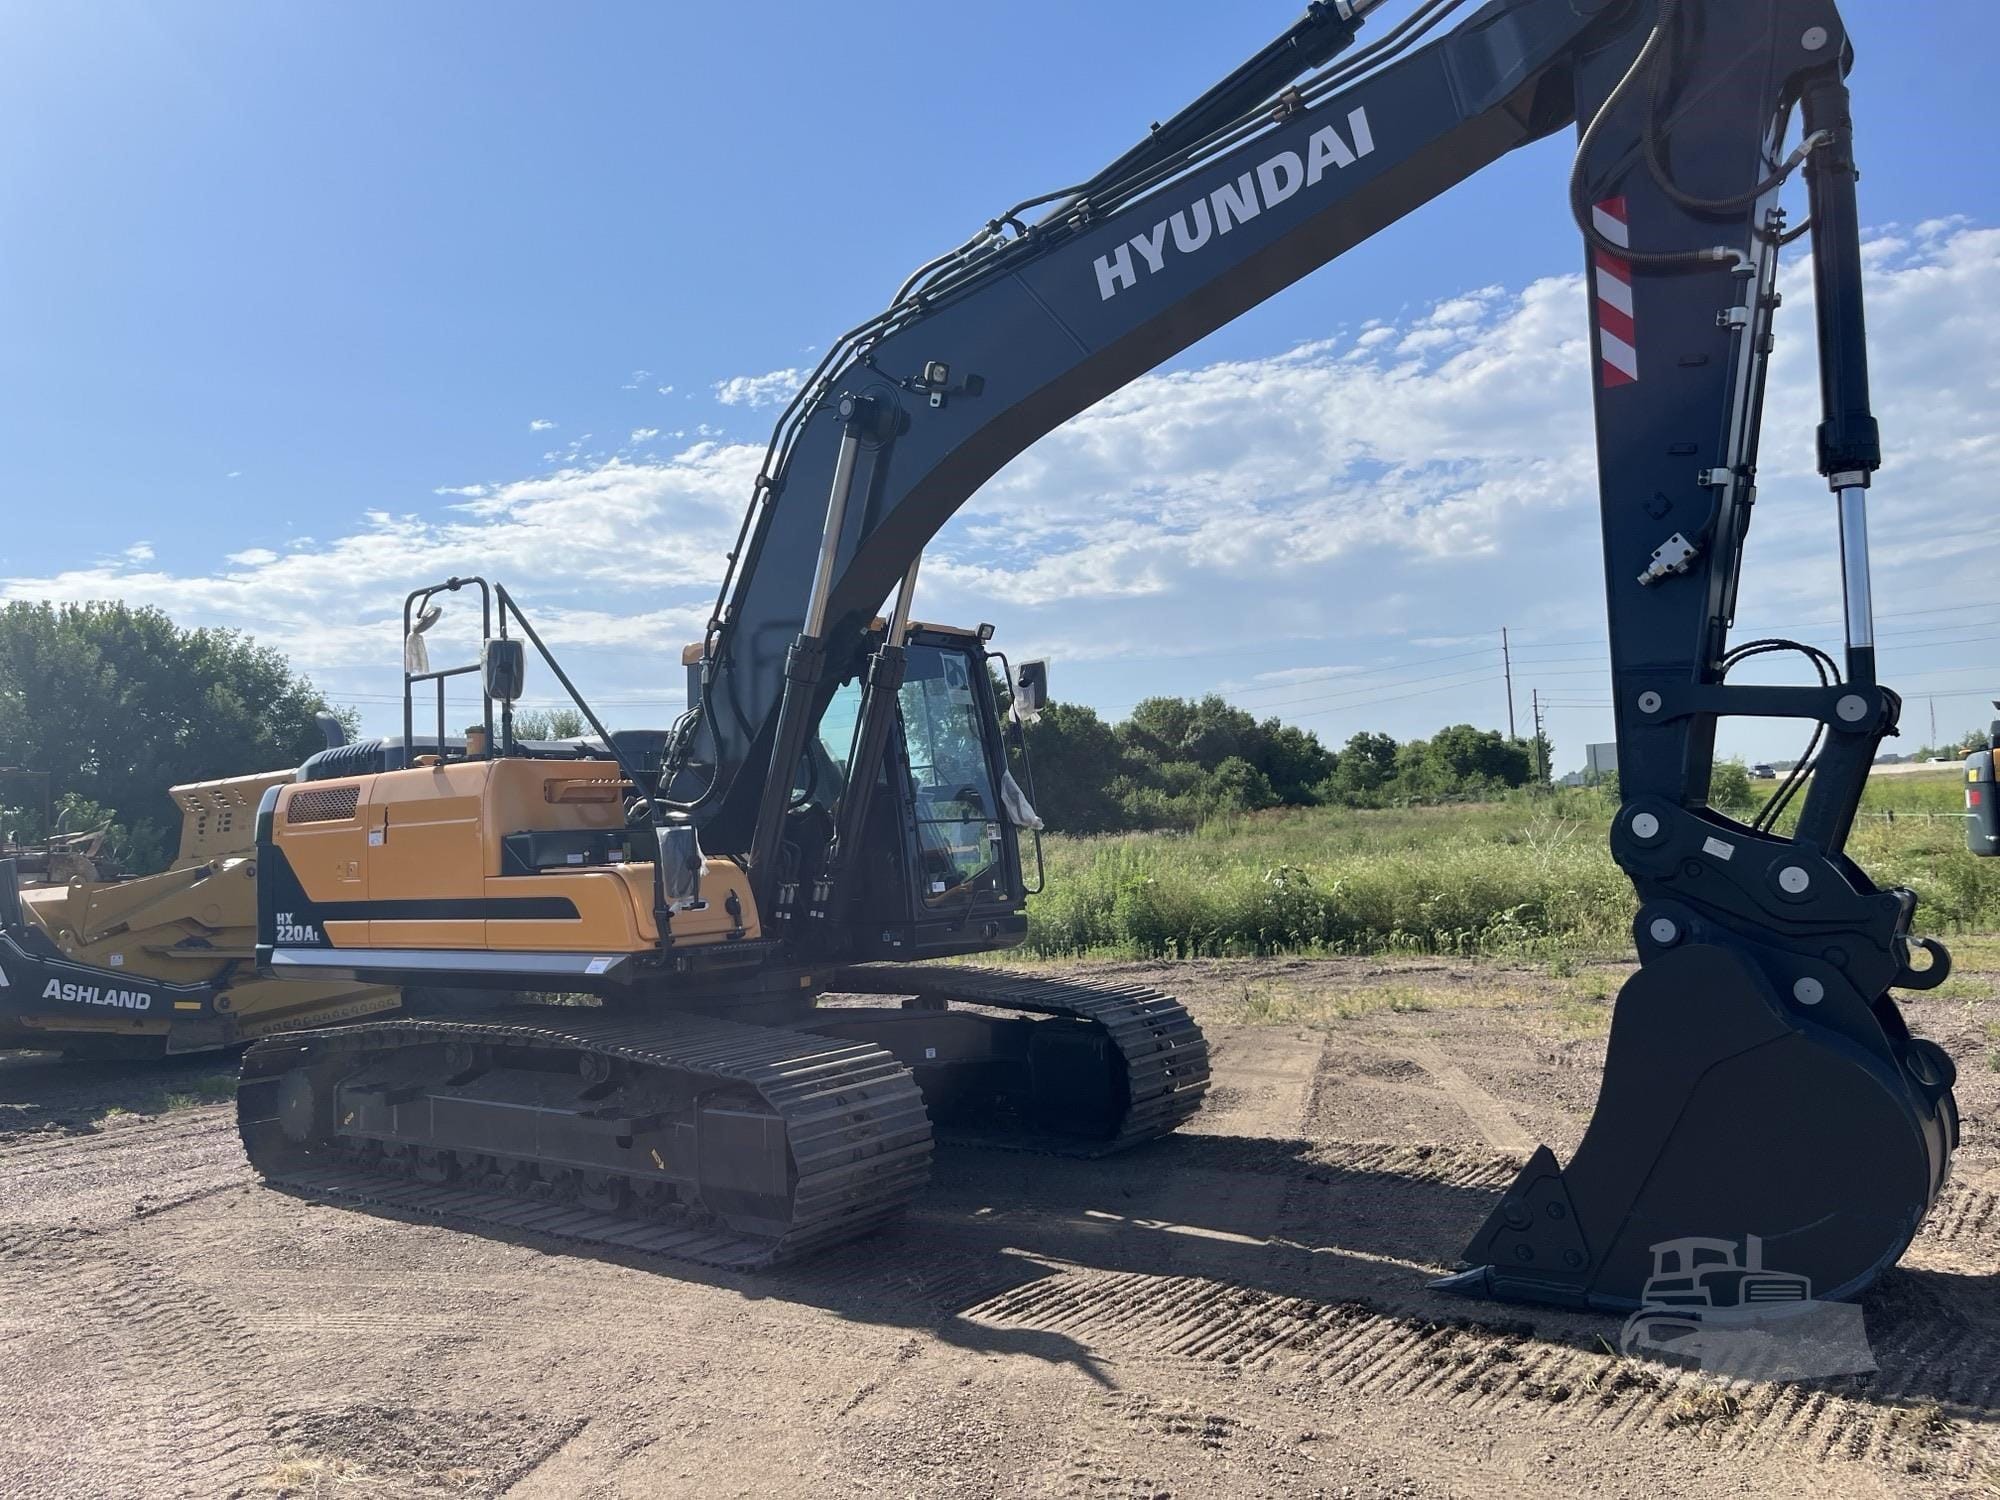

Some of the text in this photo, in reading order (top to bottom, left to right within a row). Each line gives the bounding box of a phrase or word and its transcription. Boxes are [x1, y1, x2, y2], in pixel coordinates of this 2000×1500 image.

[1092, 106, 1375, 301] HYUNDAI
[276, 912, 293, 925] HX
[42, 978, 151, 1010] ASHLAND
